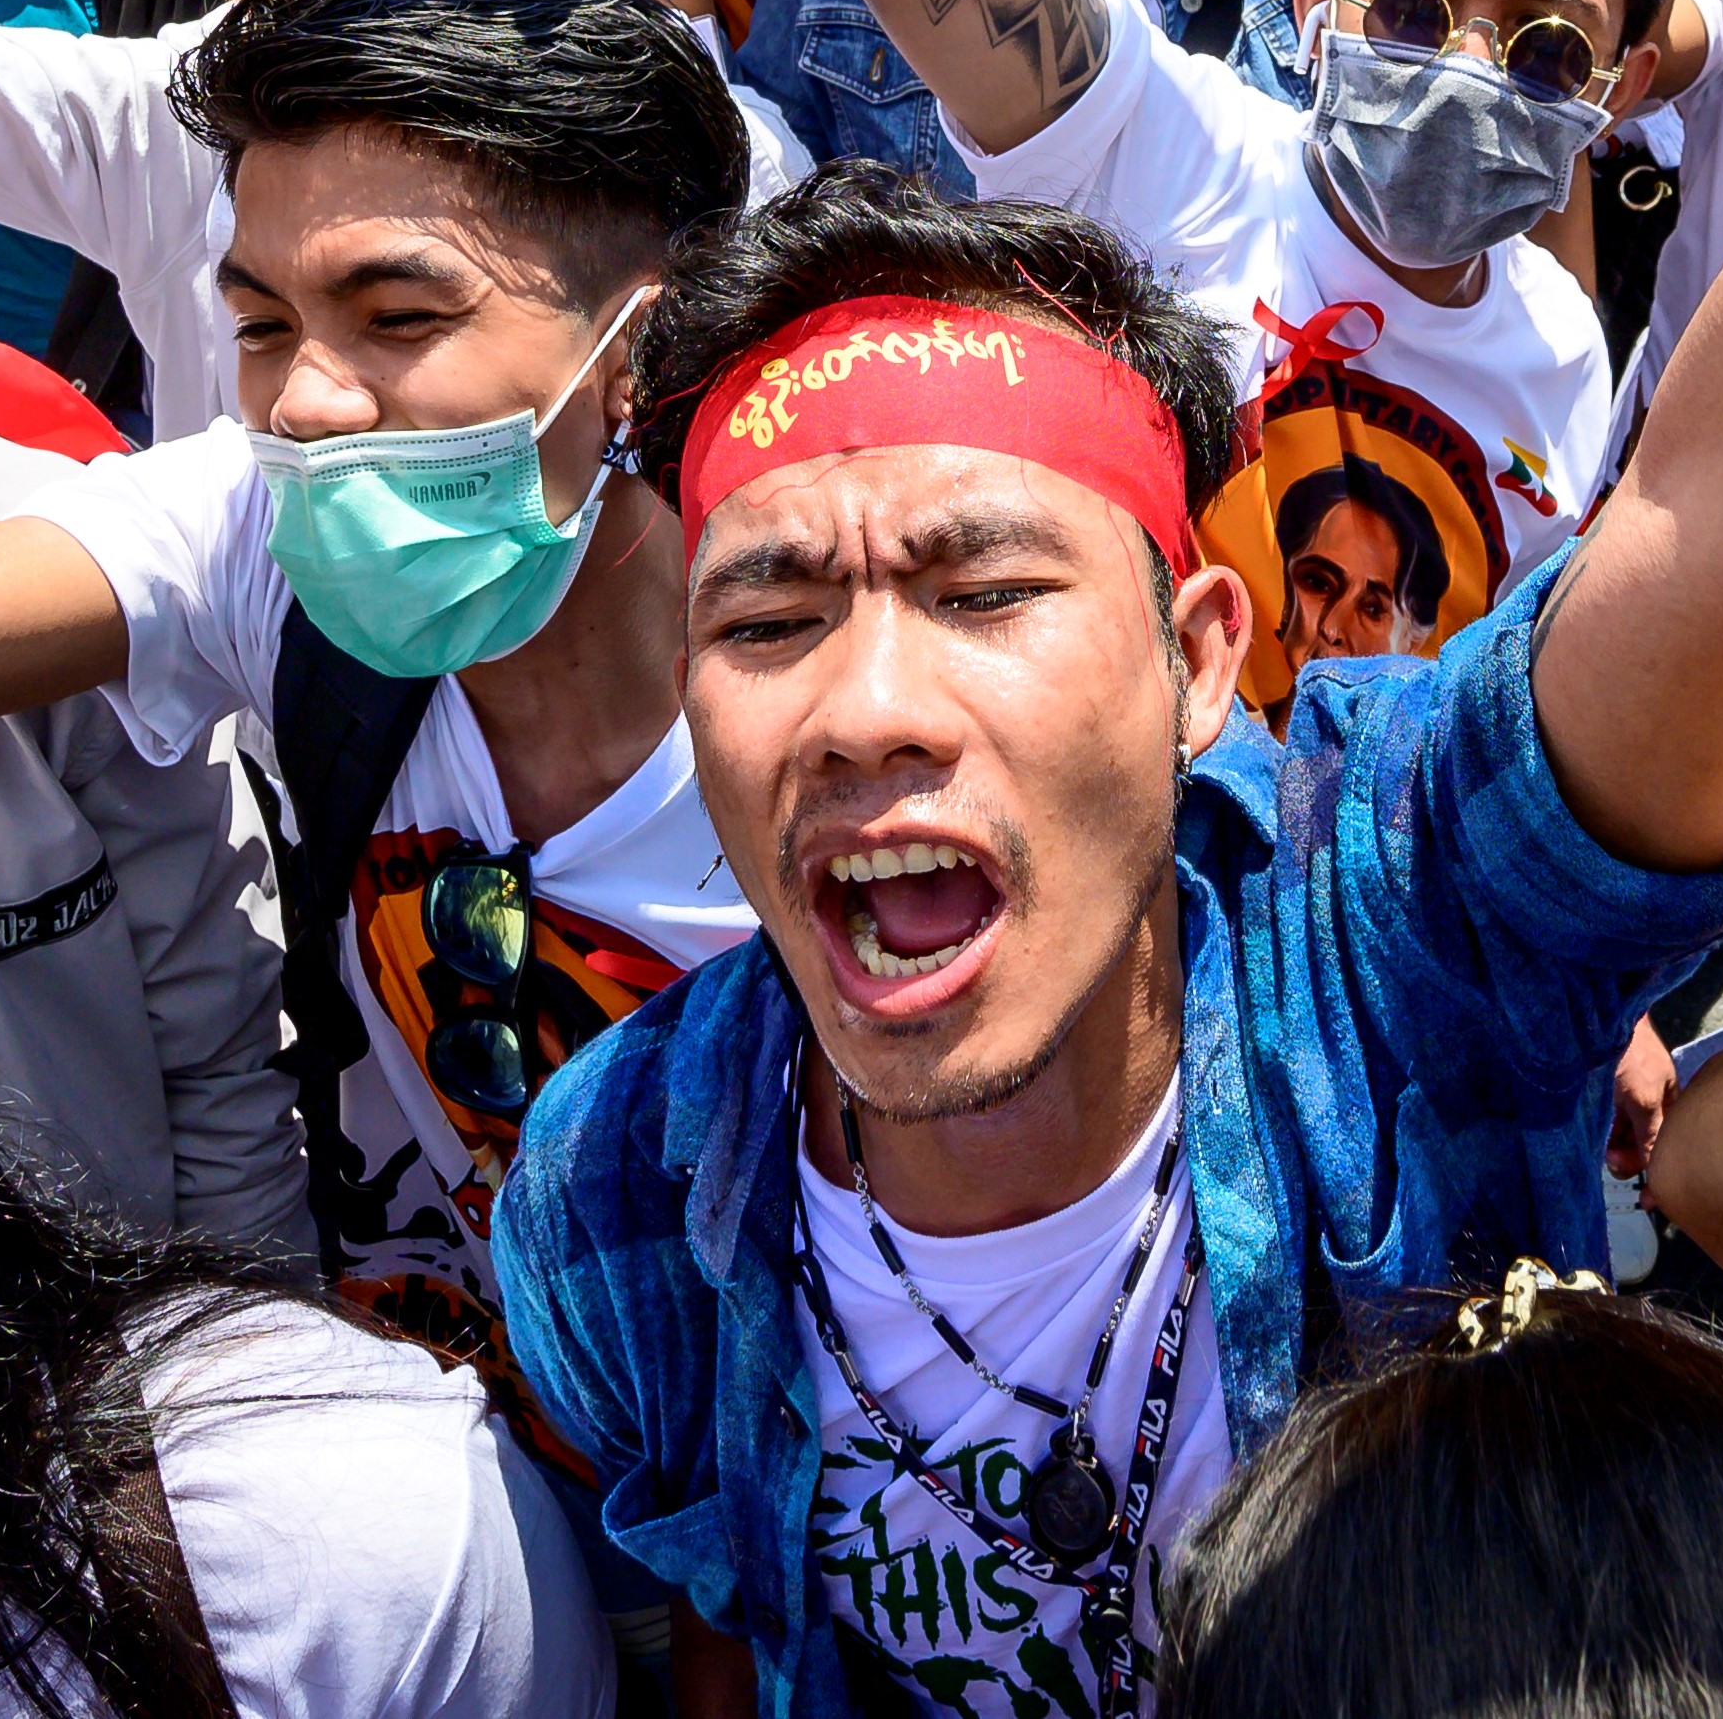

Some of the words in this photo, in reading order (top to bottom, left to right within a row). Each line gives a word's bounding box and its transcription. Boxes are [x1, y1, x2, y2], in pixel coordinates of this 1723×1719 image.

[1155, 1308, 1183, 1377] FILA
[855, 1391, 903, 1455] FILA
[1137, 1397, 1167, 1463] FILA
[918, 1471, 975, 1524] FILA
[1121, 1482, 1149, 1546] FILA
[993, 1534, 1055, 1579] FILA
[821, 1536, 1039, 1650] THIS
[1111, 1633, 1134, 1692] FILA
